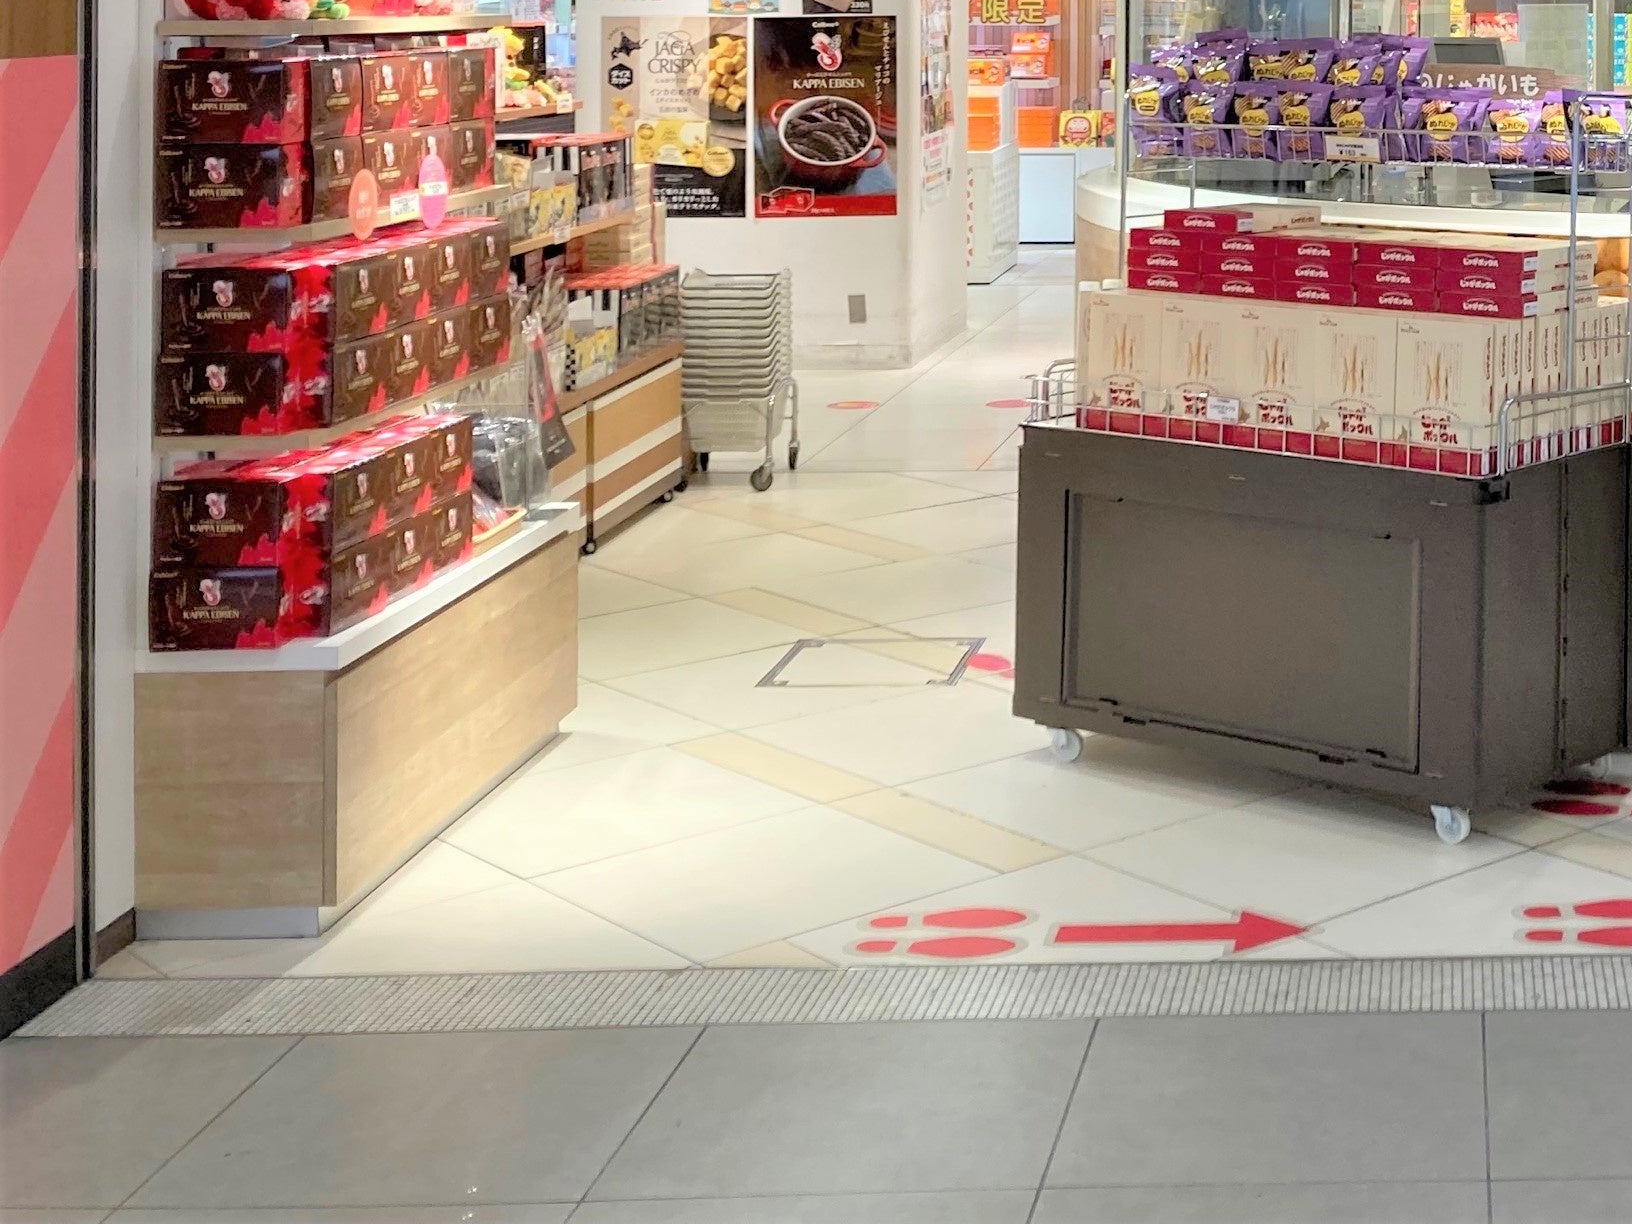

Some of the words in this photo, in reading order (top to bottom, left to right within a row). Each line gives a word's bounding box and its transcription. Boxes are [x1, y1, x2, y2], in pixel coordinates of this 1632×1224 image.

[655, 39, 696, 57] JAGA
[647, 58, 702, 74] CRISPY
[792, 78, 828, 89] KAPPA
[828, 78, 866, 89] EBISEN
